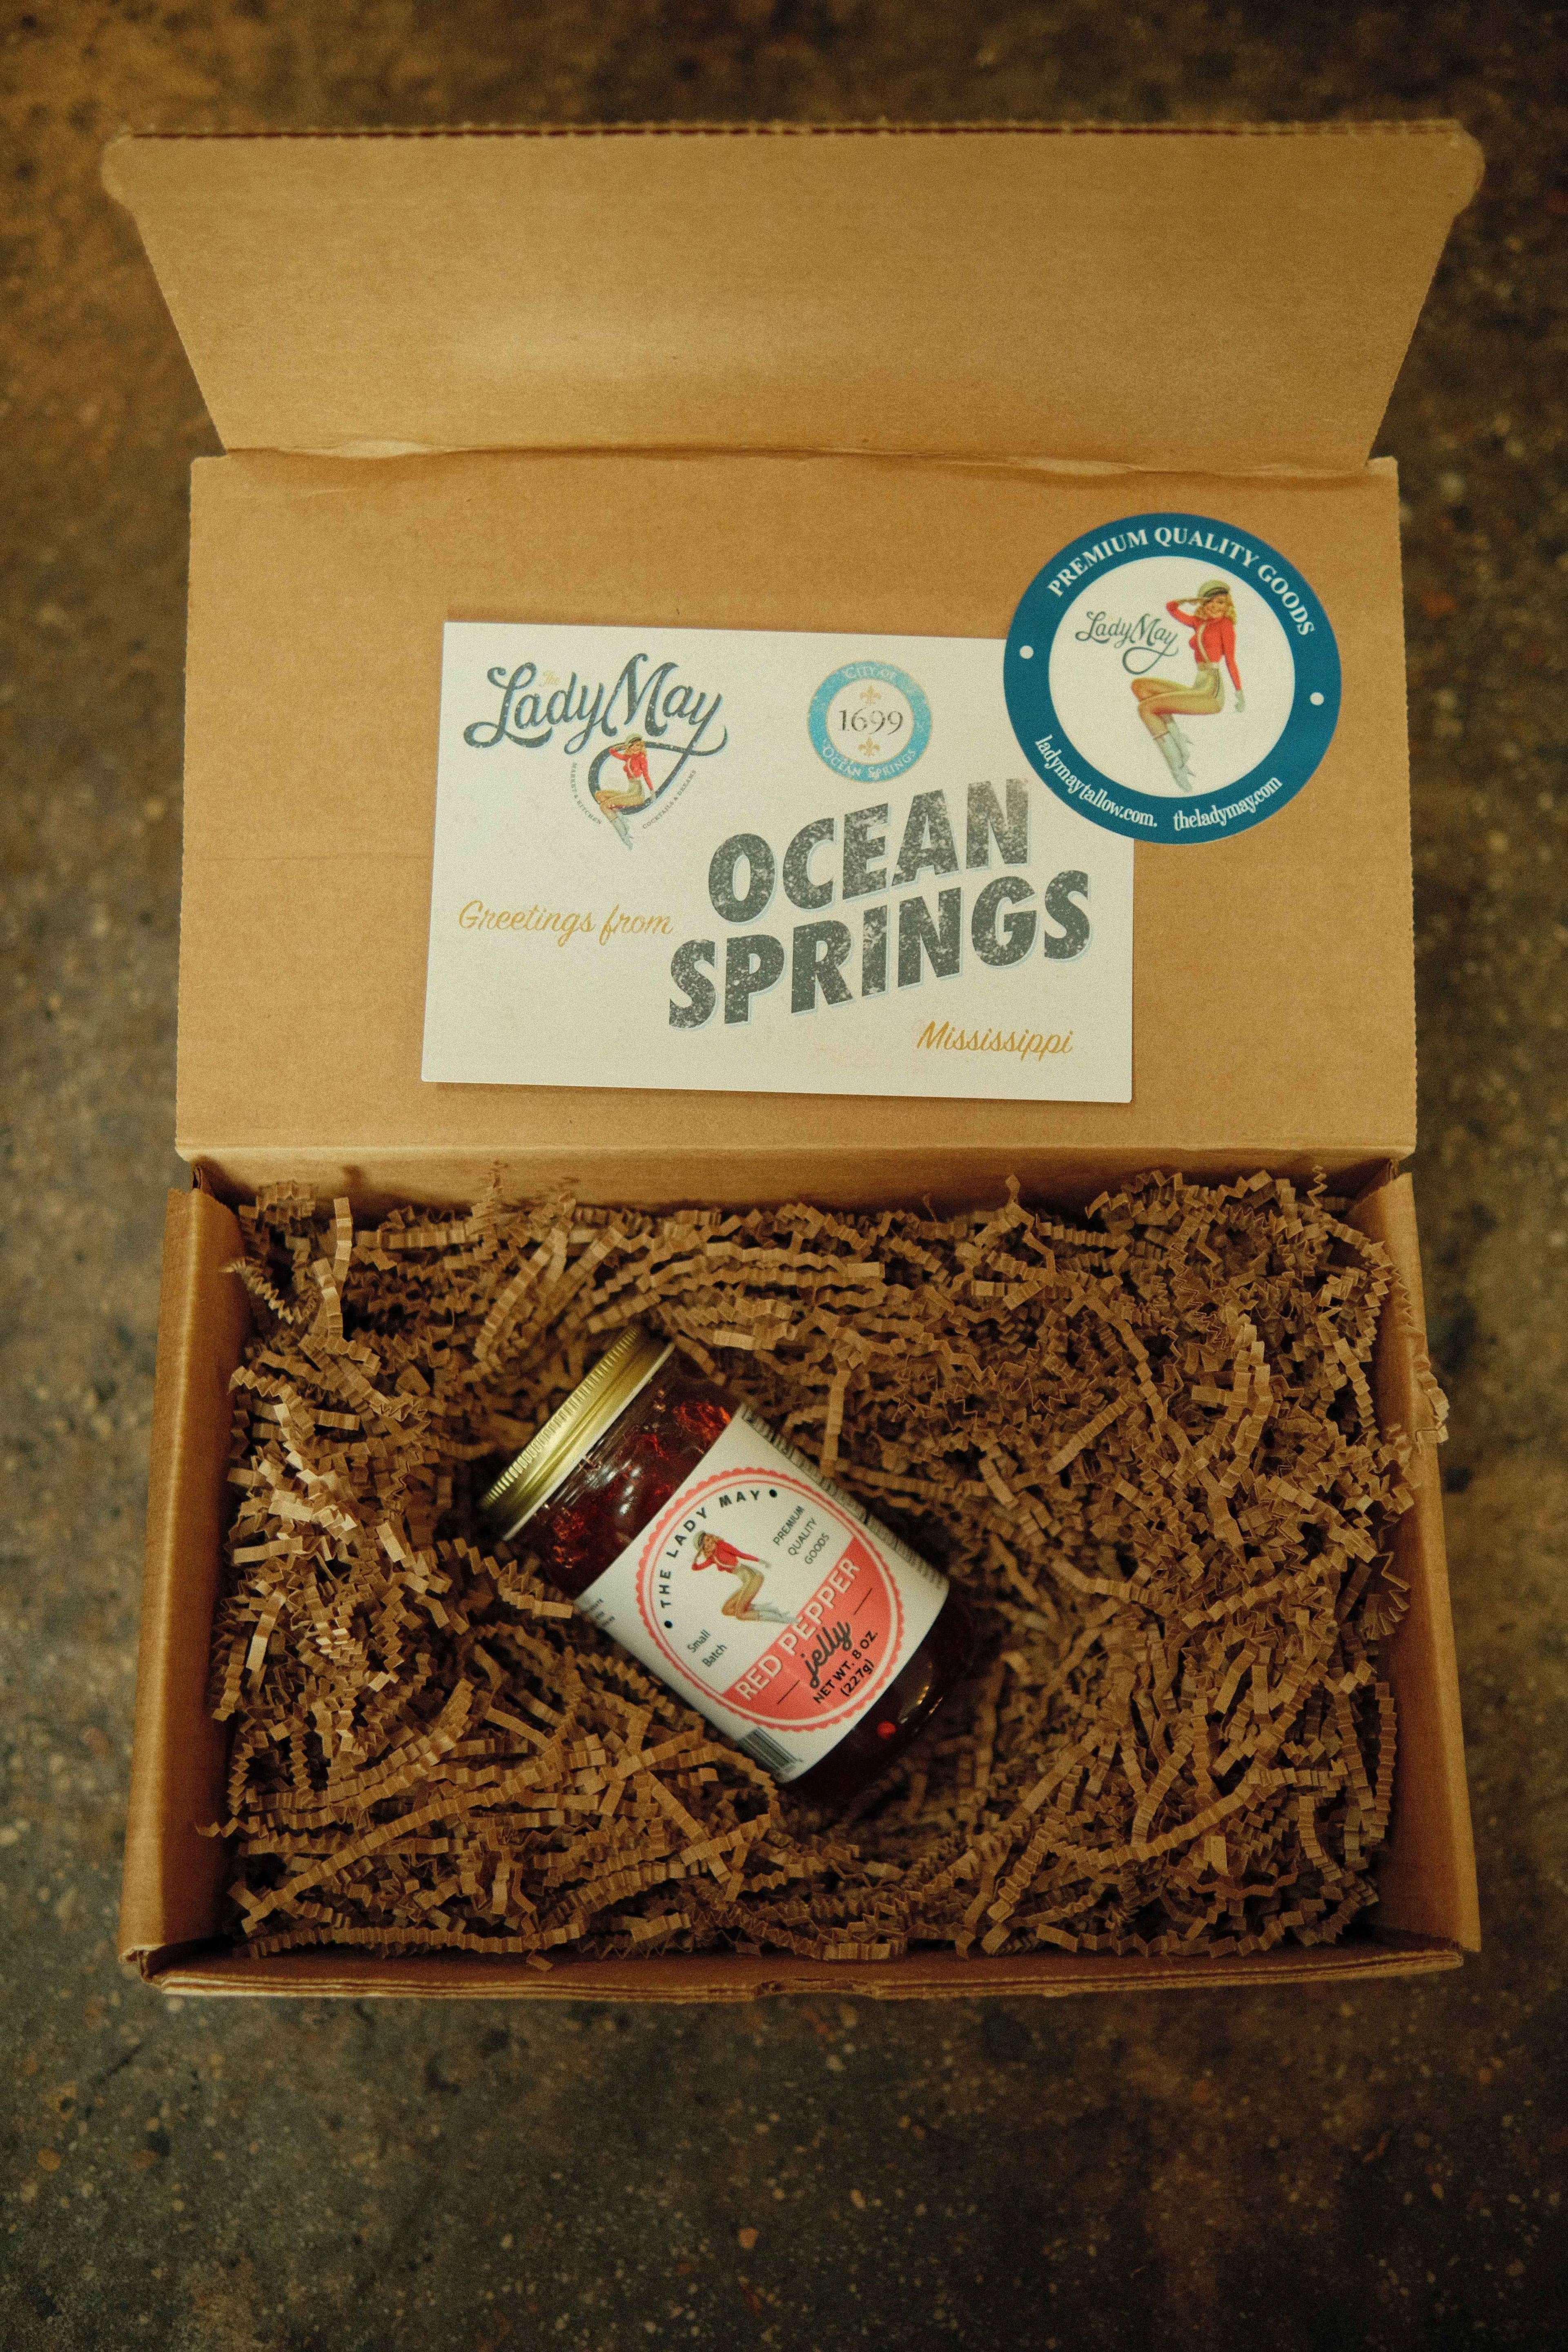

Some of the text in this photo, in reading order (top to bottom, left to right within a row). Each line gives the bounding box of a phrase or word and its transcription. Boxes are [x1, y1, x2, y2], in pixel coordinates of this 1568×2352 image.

[1047, 527, 1315, 636] PREMIUM QUALITY GOODS
[839, 707, 904, 735] 1699
[822, 745, 916, 779] OCEAN SPRINGS
[1036, 735, 1283, 832] ladymaytallow.com. theladymay.com
[577, 800, 602, 824] KITCHEN
[642, 801, 674, 829] COCKTAILS
[677, 770, 696, 796] DREAMS
[708, 778, 1030, 924] OCEAN
[459, 900, 674, 947] Greetings from
[669, 870, 1092, 1030] SPRINGS
[917, 1020, 1074, 1062] Mississippi
[773, 1506, 804, 1546] PREMIUM
[788, 1518, 817, 1555] QUALITY
[805, 1532, 829, 1564] GOODS
[659, 1490, 760, 1608] THE LADY MAY
[687, 1628, 711, 1653] Small
[735, 1654, 783, 1701] RED
[777, 1557, 860, 1655] PEPPER
[702, 1644, 727, 1666] Batch
[800, 1621, 853, 1689] jelly
[813, 1630, 878, 1704] NET WT. 8 OZ.
[840, 1659, 875, 1697] (227g)
